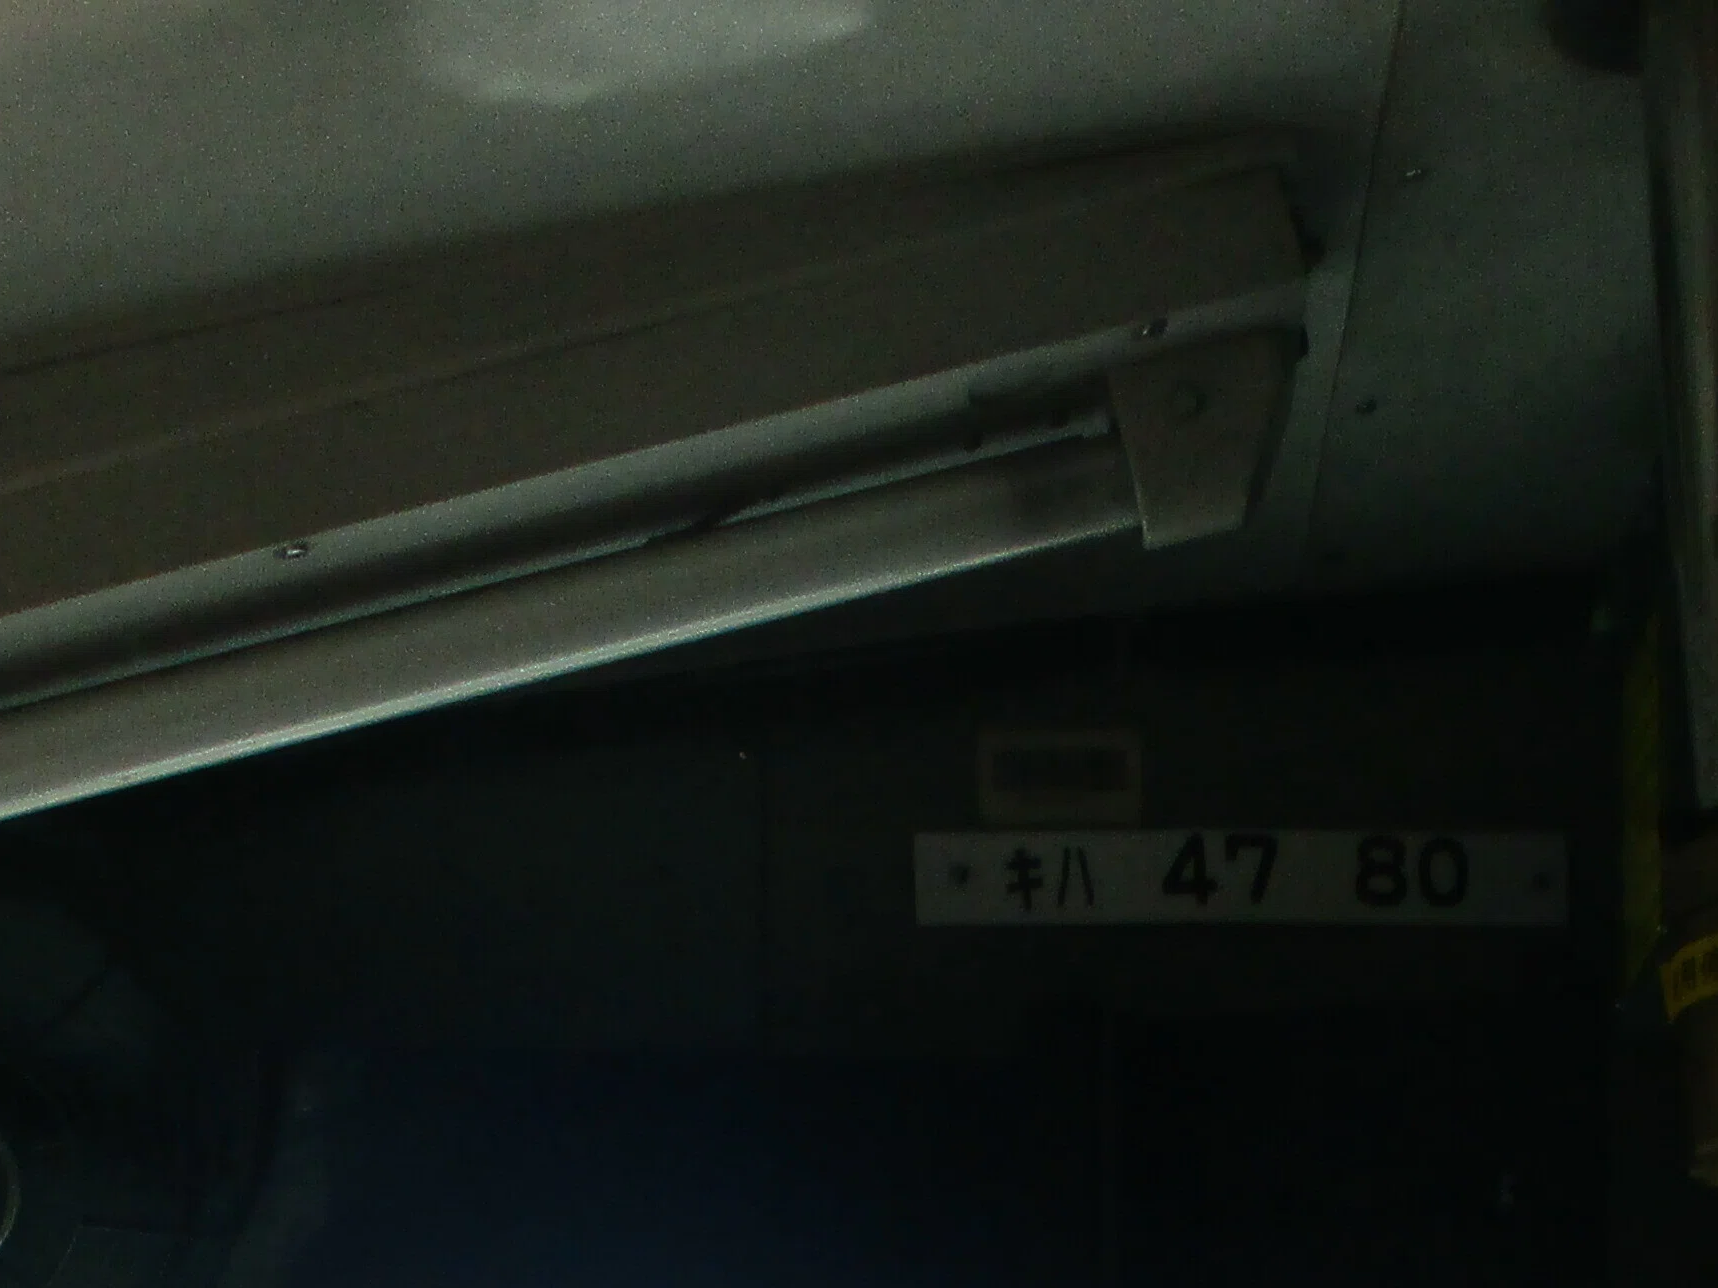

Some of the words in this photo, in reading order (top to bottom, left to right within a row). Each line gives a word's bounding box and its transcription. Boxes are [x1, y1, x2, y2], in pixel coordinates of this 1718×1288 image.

[1003, 846, 1097, 911] キハ
[1161, 831, 1279, 907] 47
[1355, 833, 1470, 909] 80
